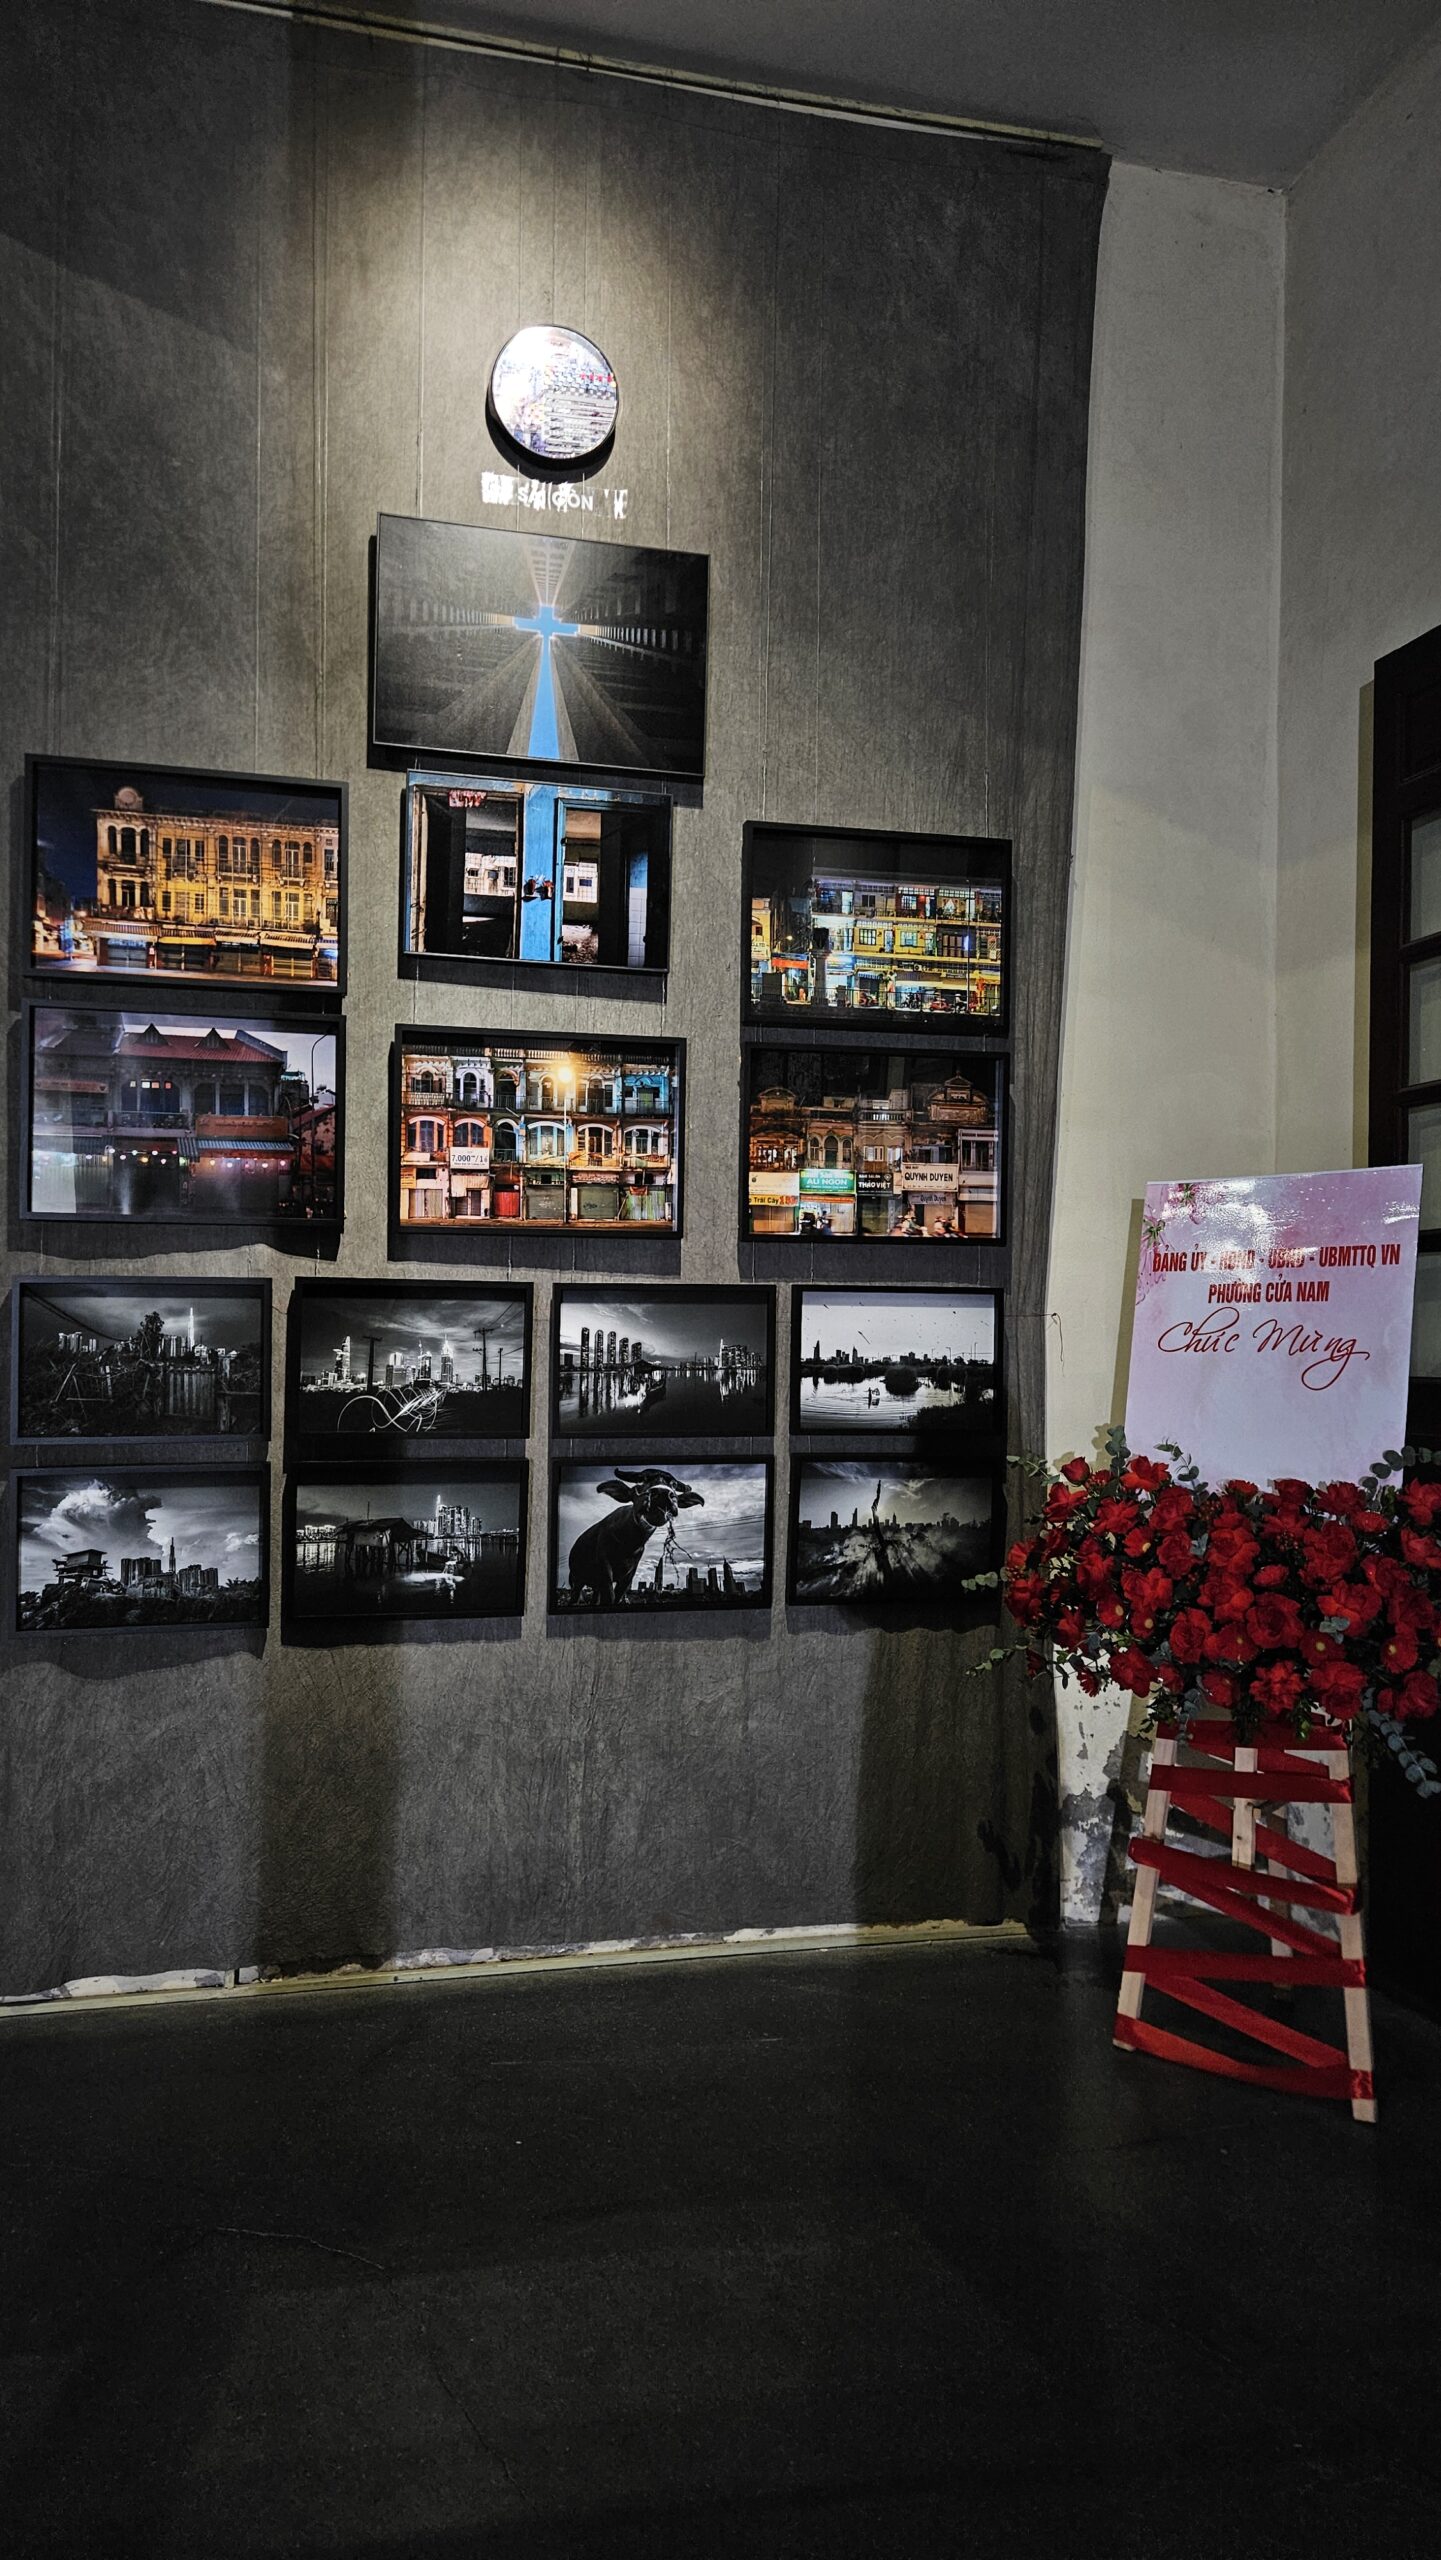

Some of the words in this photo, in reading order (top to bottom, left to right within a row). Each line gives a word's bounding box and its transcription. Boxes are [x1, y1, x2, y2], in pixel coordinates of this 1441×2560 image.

[1152, 1244, 1188, 1272] ĐẢNG
[1190, 1243, 1207, 1272] ỦY
[1268, 1247, 1305, 1269] UBND
[1319, 1244, 1377, 1269] UBMTTQ
[1381, 1243, 1401, 1265] VN
[1207, 1277, 1262, 1304] PHƯỜNG
[1265, 1273, 1292, 1303] CỬA
[1296, 1280, 1330, 1302] NAM
[1157, 1306, 1240, 1353] Chúc
[1252, 1318, 1371, 1391] Mừng
